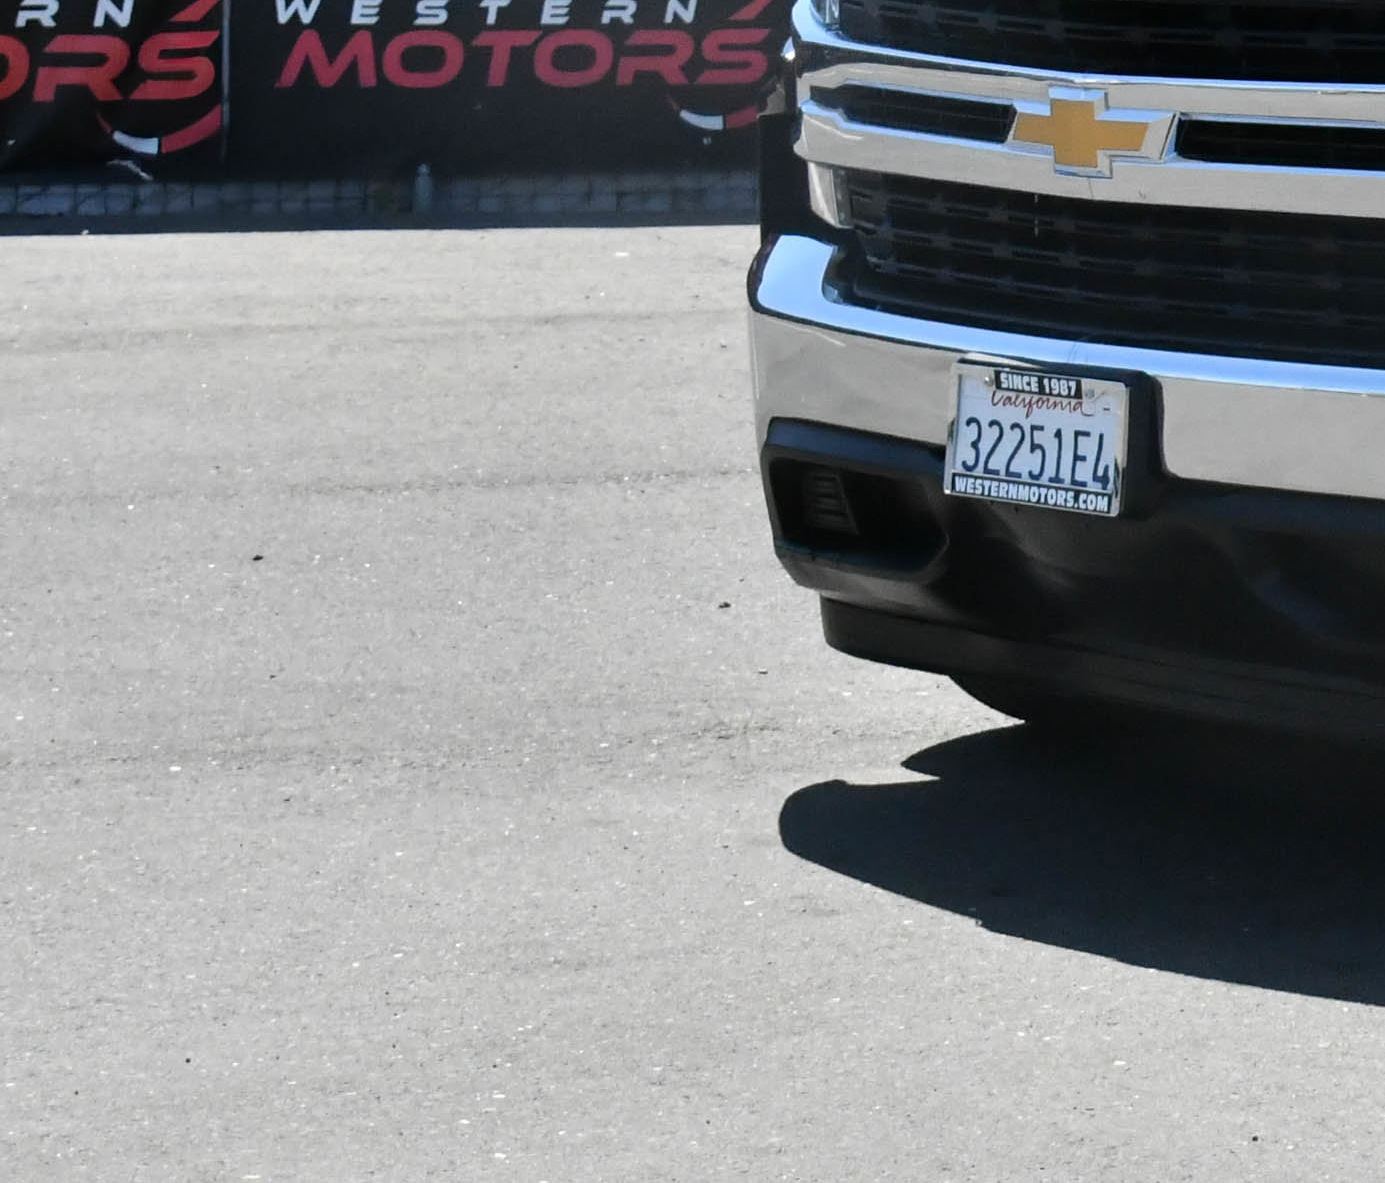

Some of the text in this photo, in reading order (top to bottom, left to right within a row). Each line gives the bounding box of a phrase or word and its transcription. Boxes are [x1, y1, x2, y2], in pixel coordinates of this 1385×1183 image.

[276, 28, 769, 89] MOTORS
[1000, 372, 1077, 397] SINCE 1987
[991, 389, 1095, 419] California
[961, 416, 1111, 491] 32251E4
[954, 476, 1109, 512] WESTERNMOTORS.COM
